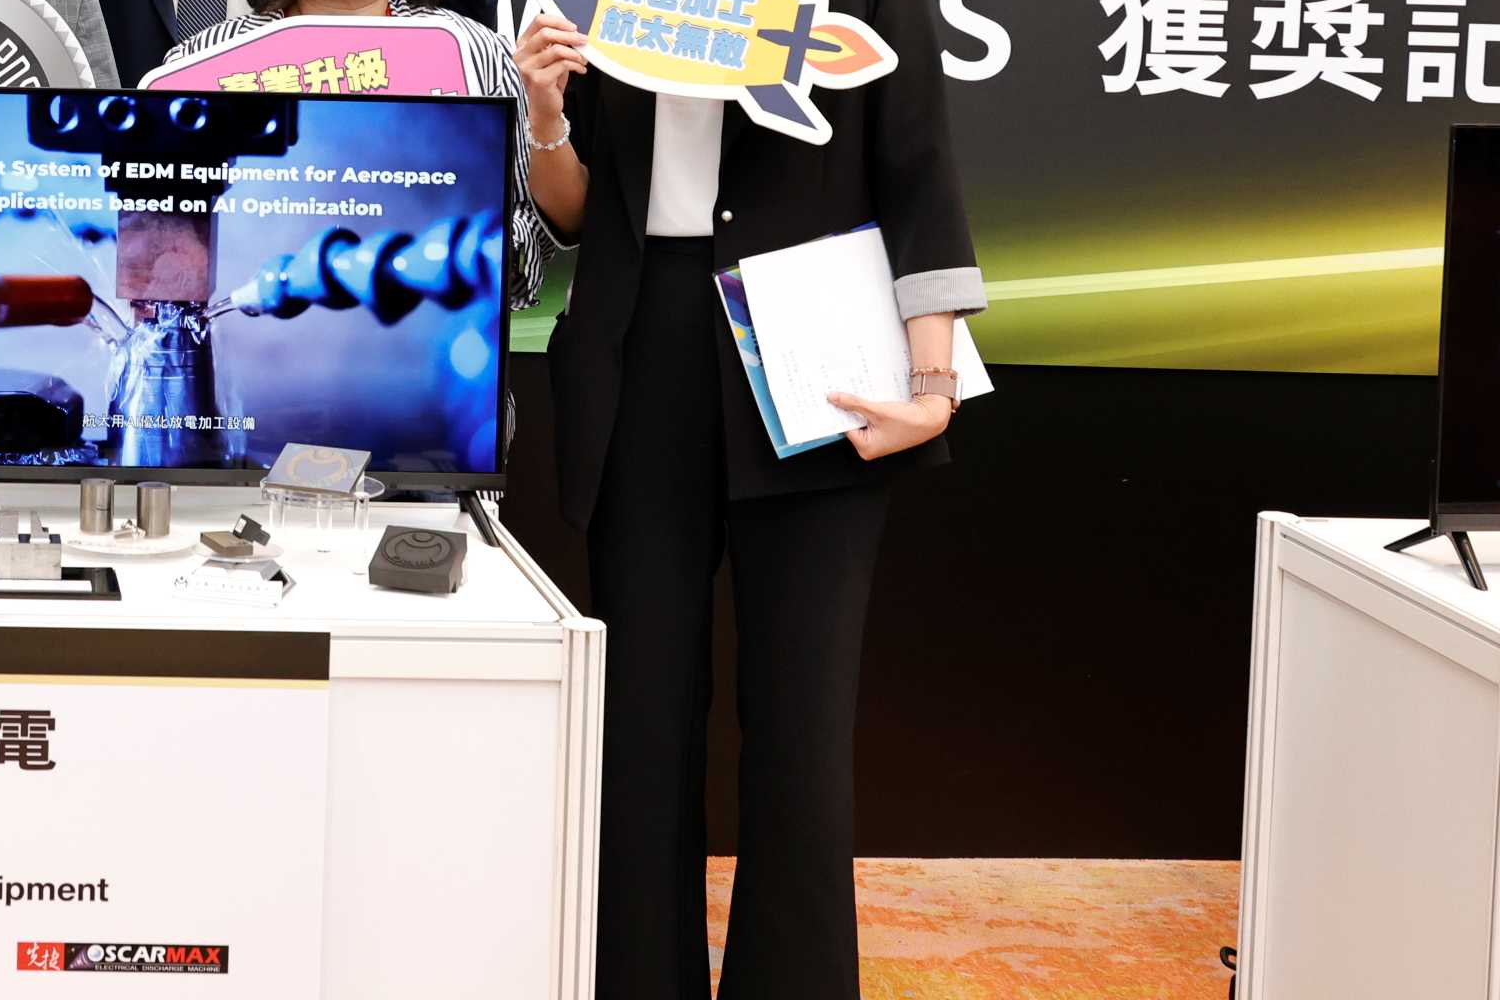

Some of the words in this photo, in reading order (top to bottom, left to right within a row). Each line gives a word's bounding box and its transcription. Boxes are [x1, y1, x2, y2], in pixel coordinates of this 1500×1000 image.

[600, 7, 750, 70] 航太無敵
[12, 159, 92, 182] System
[97, 161, 120, 179] of
[126, 162, 175, 180] EDM
[181, 163, 299, 186] Equipment
[305, 165, 336, 183] for
[342, 167, 457, 189] Aerospace
[109, 195, 173, 214] based
[179, 199, 208, 214] on
[212, 196, 236, 214] AI
[242, 198, 383, 218] Optimization
[82, 414, 255, 431] 航太用AI優化放電加工設備
[87, 944, 221, 964] OSCARMAX
[95, 964, 138, 972] ELECTRICAL
